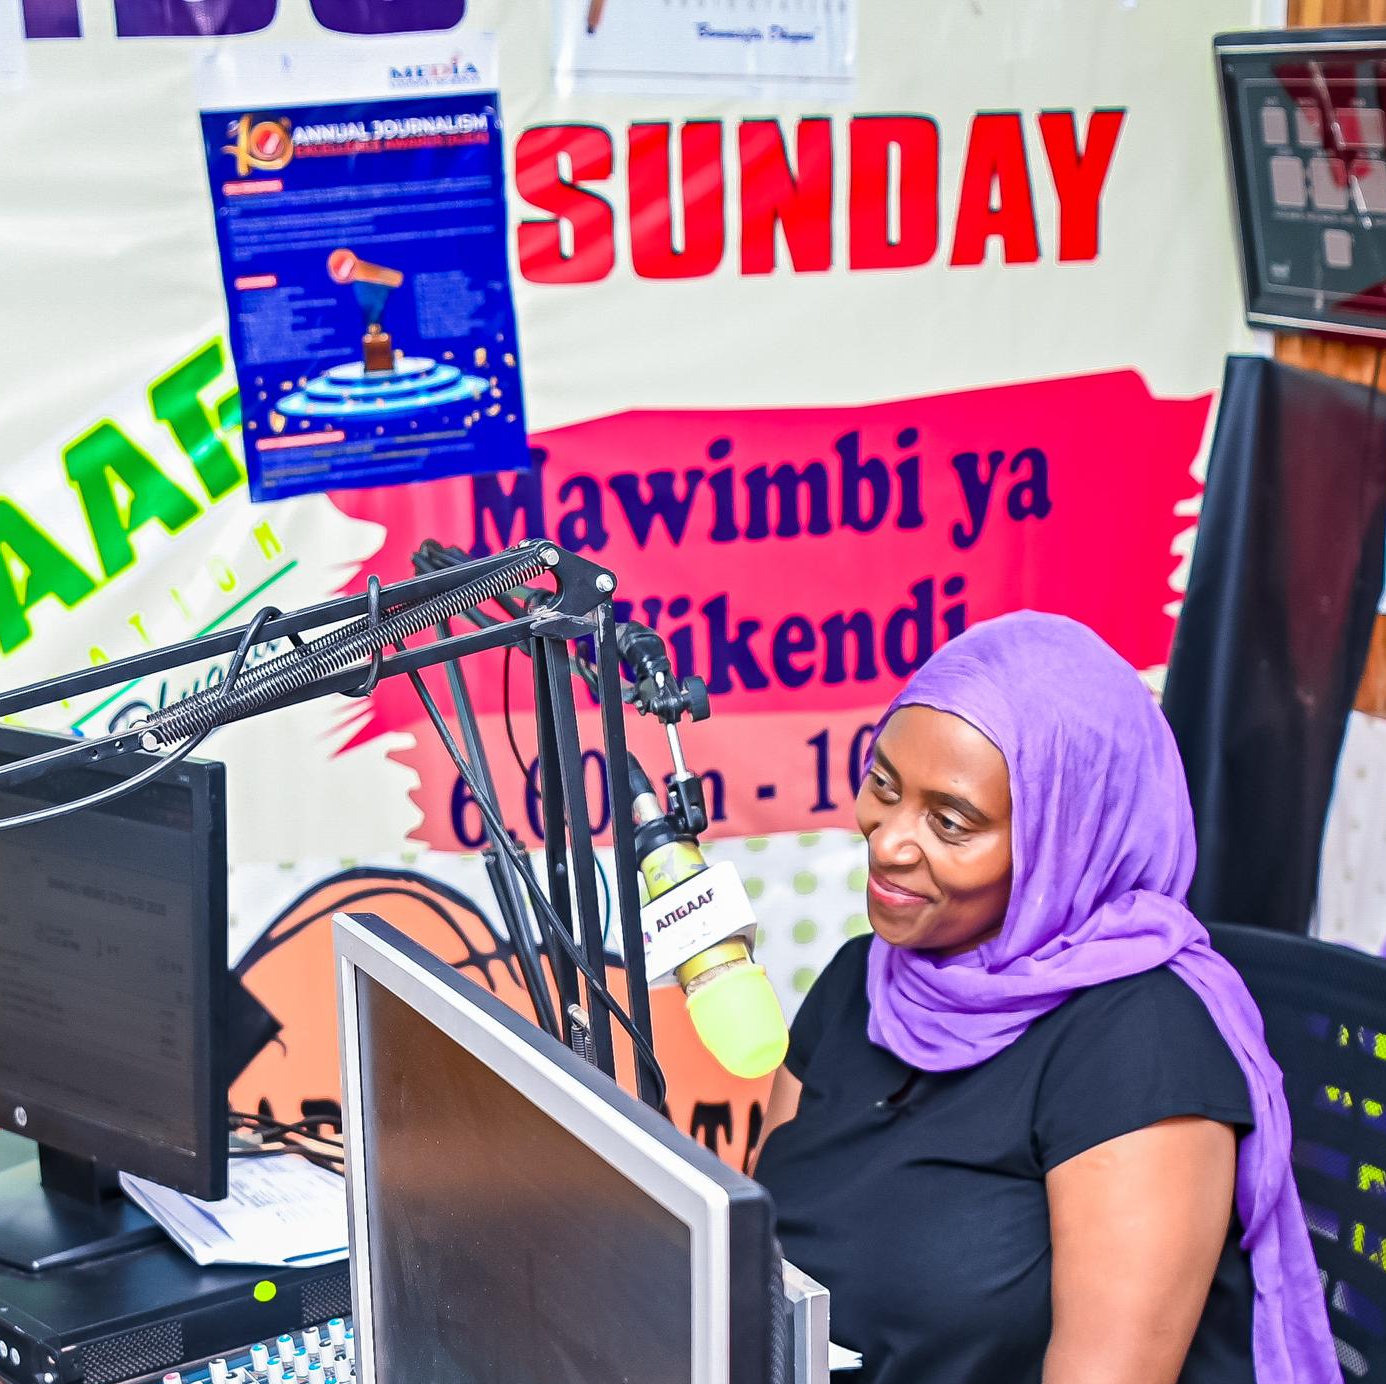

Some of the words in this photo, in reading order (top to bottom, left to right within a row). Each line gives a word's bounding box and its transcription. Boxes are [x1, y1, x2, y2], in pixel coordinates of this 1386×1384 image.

[389, 55, 479, 79] MEDIA
[293, 122, 370, 145] ANNUAL
[370, 113, 489, 141] JOURNALISM
[515, 108, 1127, 284] SUNDAY
[953, 447, 1053, 550] ya
[655, 886, 716, 932] ANGAAF
